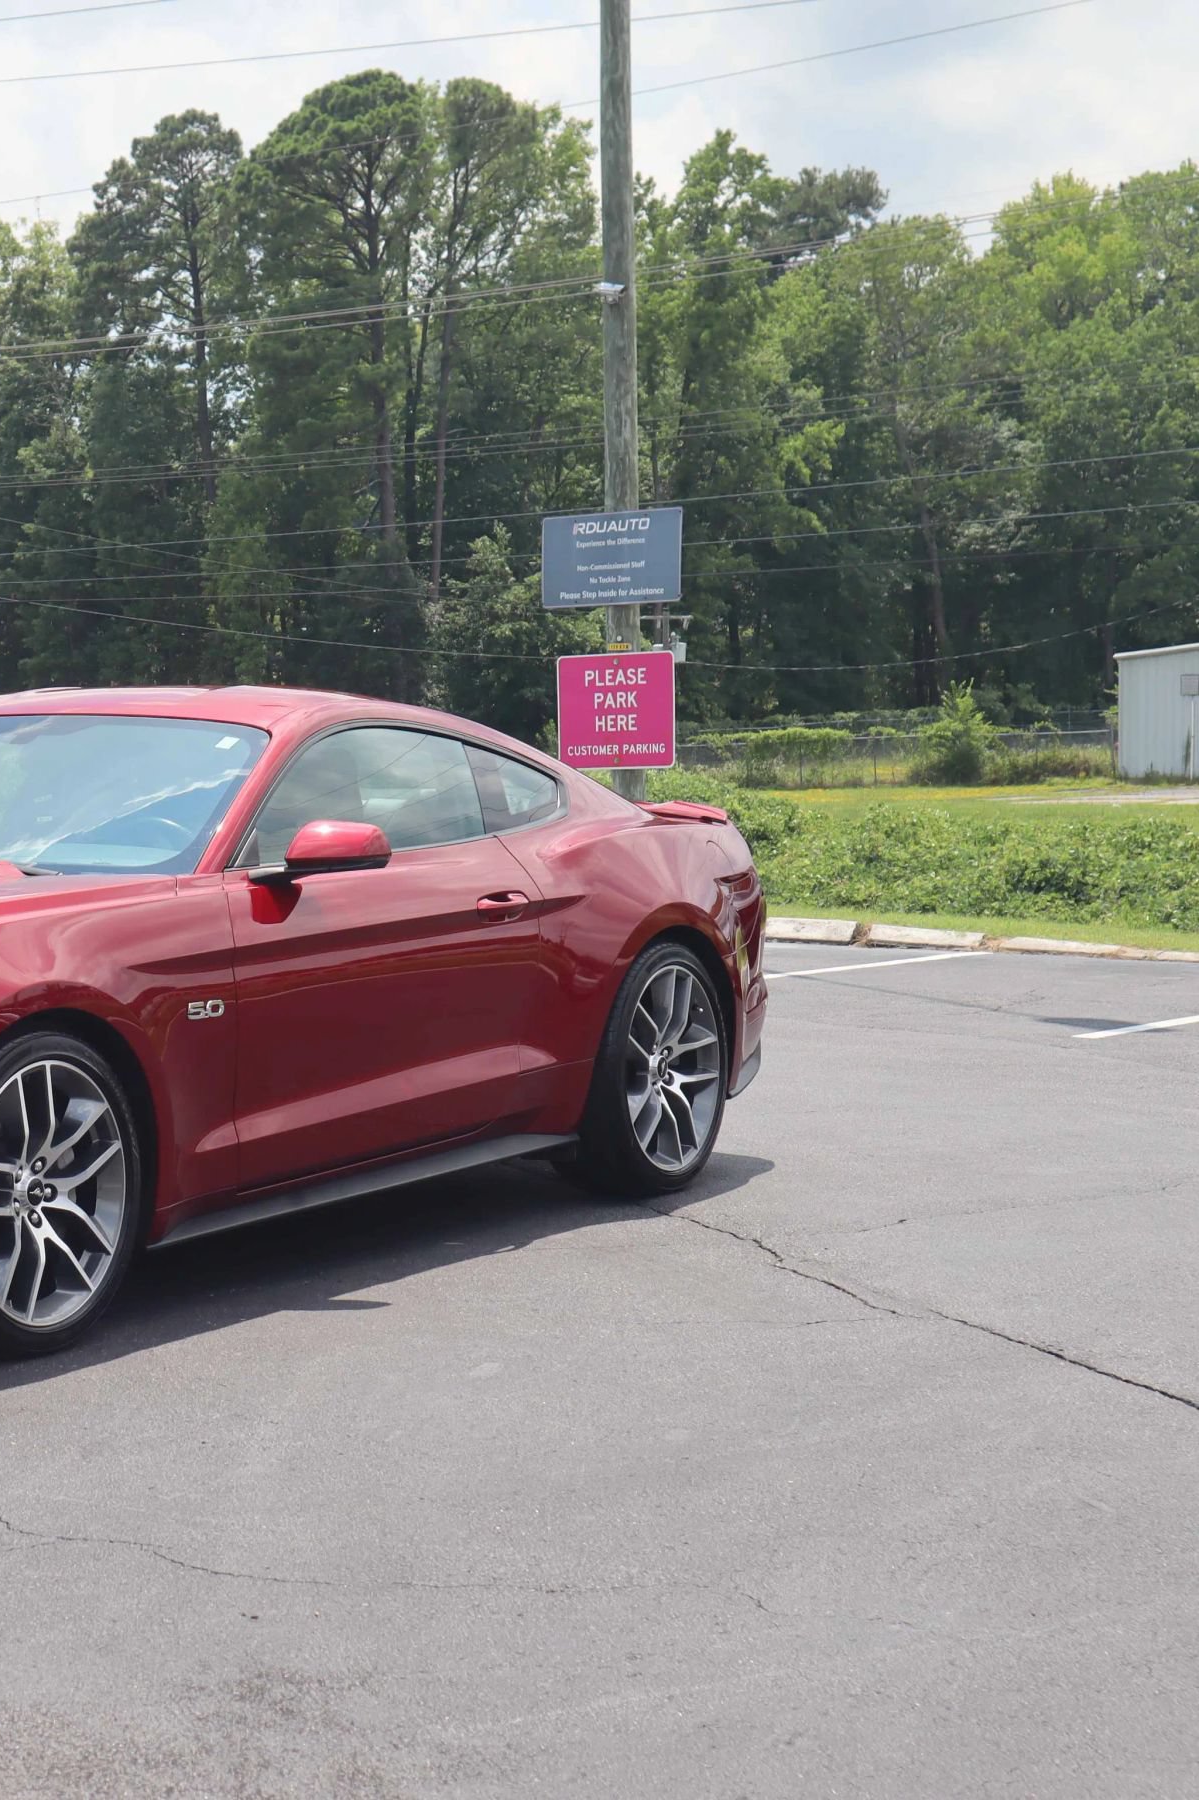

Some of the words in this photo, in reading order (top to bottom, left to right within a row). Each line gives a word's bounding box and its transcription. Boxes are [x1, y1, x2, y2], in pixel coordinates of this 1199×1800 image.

[576, 540, 605, 549] Experience
[617, 537, 645, 545] Difference
[577, 562, 630, 571] Non-Commissioned
[631, 560, 645, 568] Staff
[560, 591, 581, 600] Please
[582, 590, 596, 599] Step
[598, 589, 617, 598] Inside
[619, 588, 628, 597] for
[629, 587, 664, 596] Assistance
[585, 668, 647, 687] PLEASE
[594, 691, 638, 709] PARK
[595, 714, 637, 732] HERE
[567, 744, 619, 756] CUSTOMER
[622, 743, 666, 755] PARKING
[188, 999, 225, 1020] 5.0
